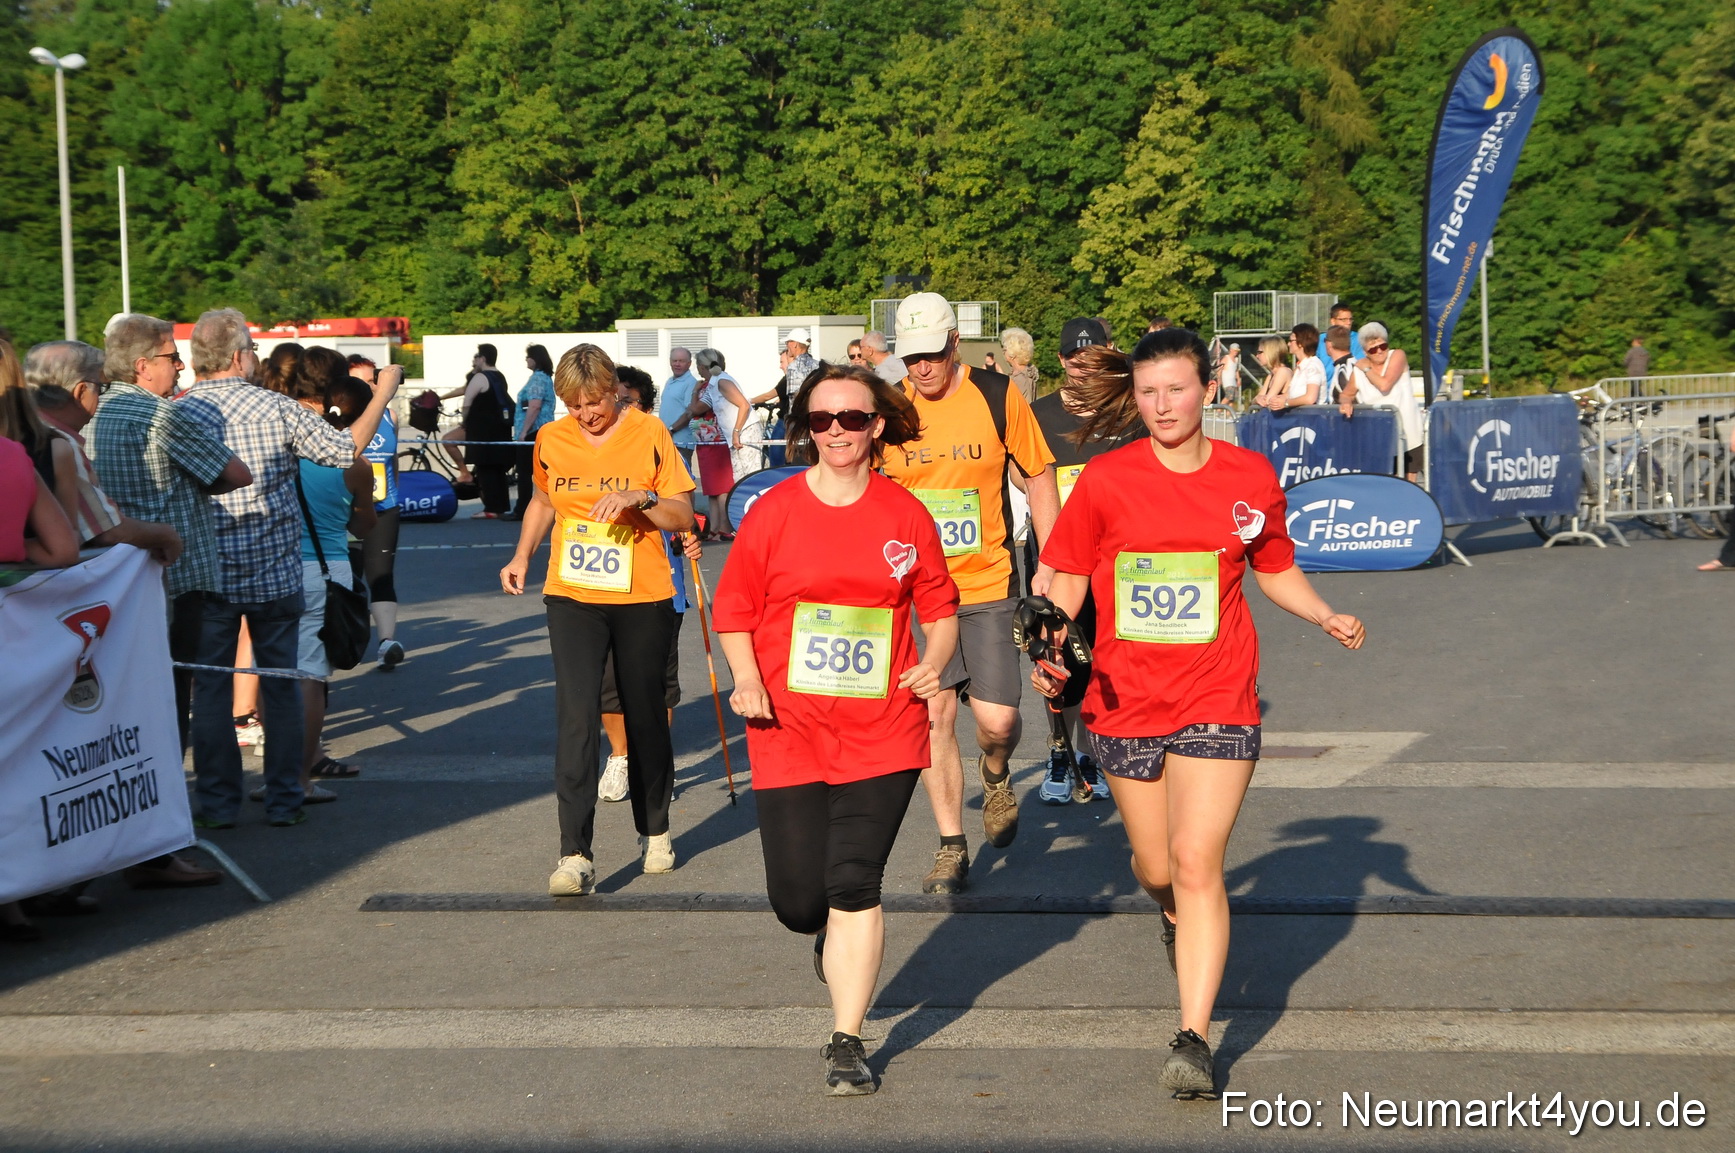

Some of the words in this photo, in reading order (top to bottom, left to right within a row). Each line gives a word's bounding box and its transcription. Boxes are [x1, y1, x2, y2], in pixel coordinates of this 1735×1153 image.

[952, 443, 982, 460] KU
[1486, 448, 1560, 483] Fischer
[555, 477, 580, 492] PE
[1491, 484, 1554, 502] AUTOMOBILE
[1308, 515, 1421, 540] Fischer
[1319, 538, 1413, 552] AUTOMOBILE
[569, 543, 620, 574] 926
[1130, 584, 1201, 620] 592
[1153, 628, 1184, 636] Landkreises
[804, 635, 874, 674] 586
[1072, 642, 1088, 663] LEKI
[818, 673, 842, 681] Angelika
[826, 681, 856, 689] Landkreises
[41, 724, 141, 782] Neumarkter
[40, 760, 160, 848] Lammsbräu
